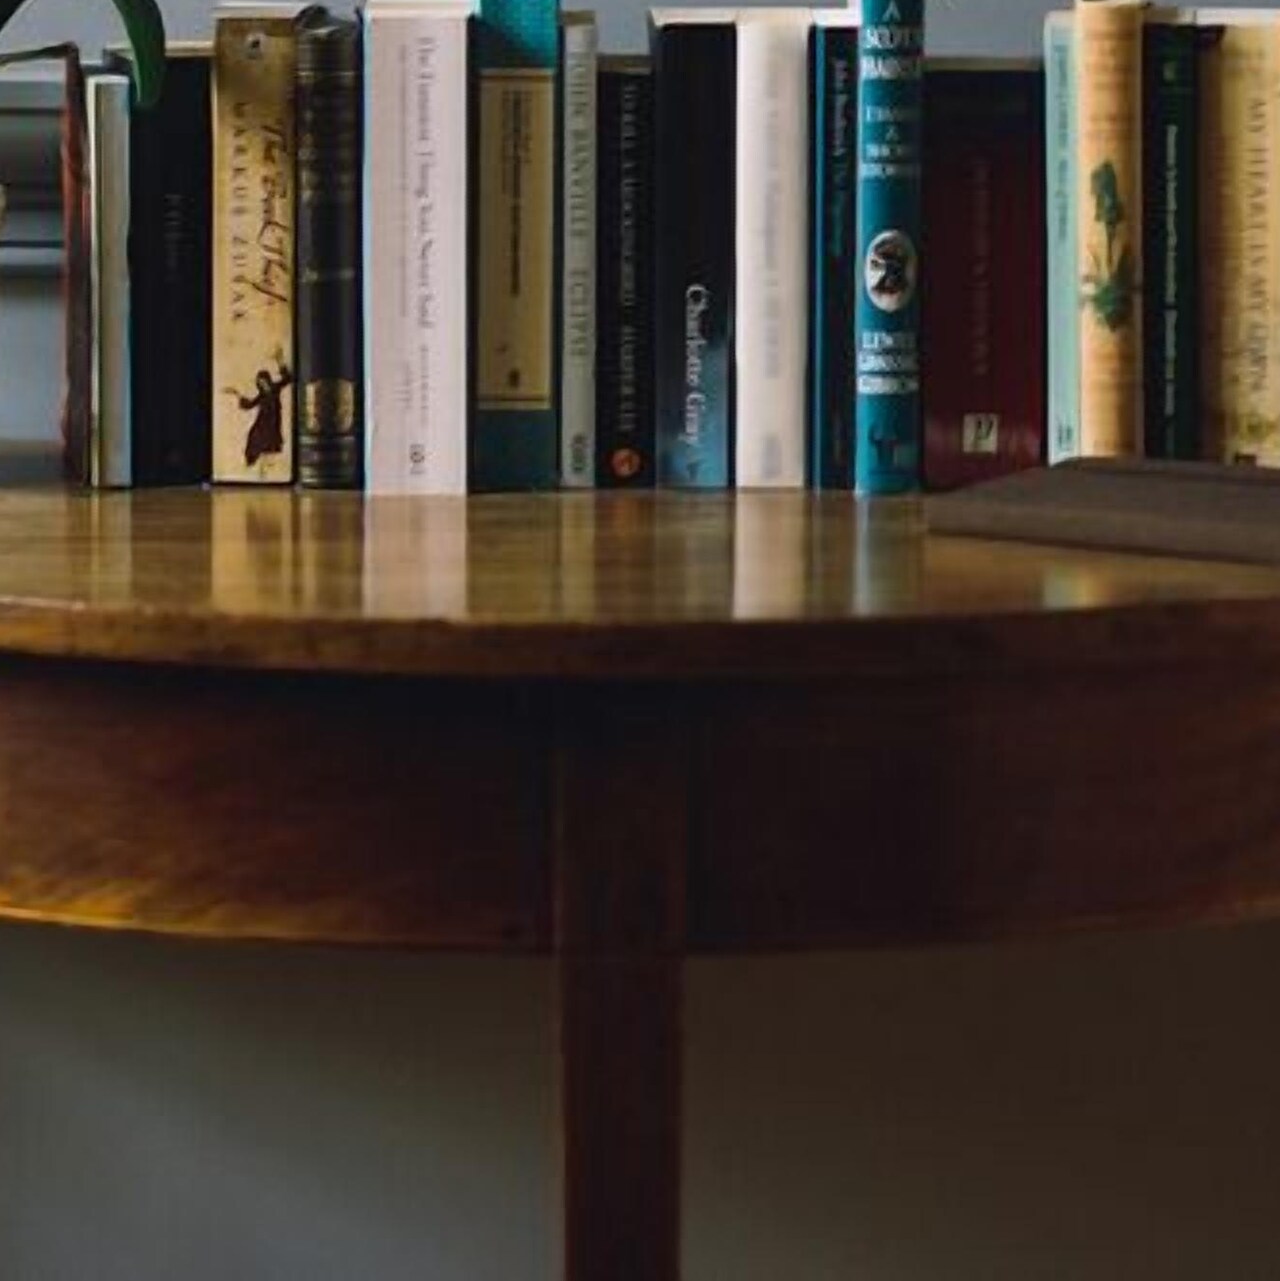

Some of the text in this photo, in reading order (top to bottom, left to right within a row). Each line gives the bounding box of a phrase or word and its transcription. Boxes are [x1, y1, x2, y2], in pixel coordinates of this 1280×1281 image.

[882, 0, 901, 22] A
[231, 102, 249, 322] MARKUS ZUSAK
[1248, 147, 1269, 231] HEART
[677, 284, 710, 447] Charlotte Gray
